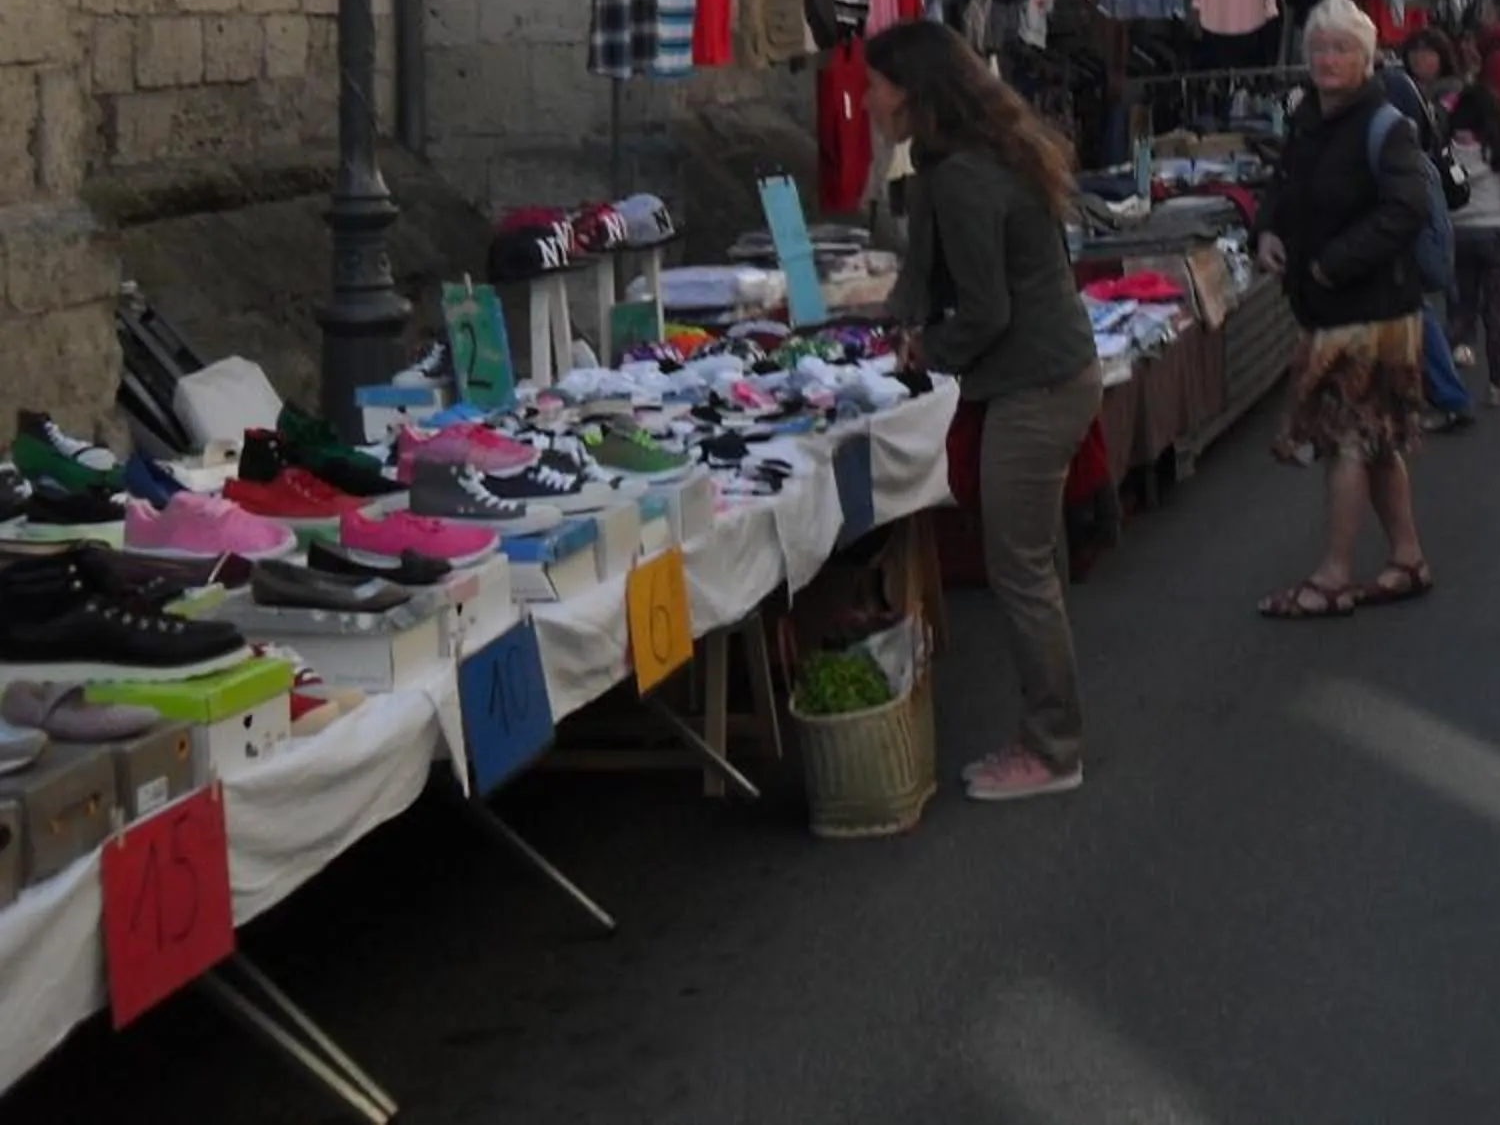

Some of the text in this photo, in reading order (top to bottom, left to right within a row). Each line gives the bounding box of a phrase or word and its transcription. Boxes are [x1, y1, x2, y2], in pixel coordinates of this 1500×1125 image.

[460, 321, 493, 390] 2
[649, 574, 673, 665] 6
[488, 644, 530, 737] 10
[129, 809, 199, 954] 15
